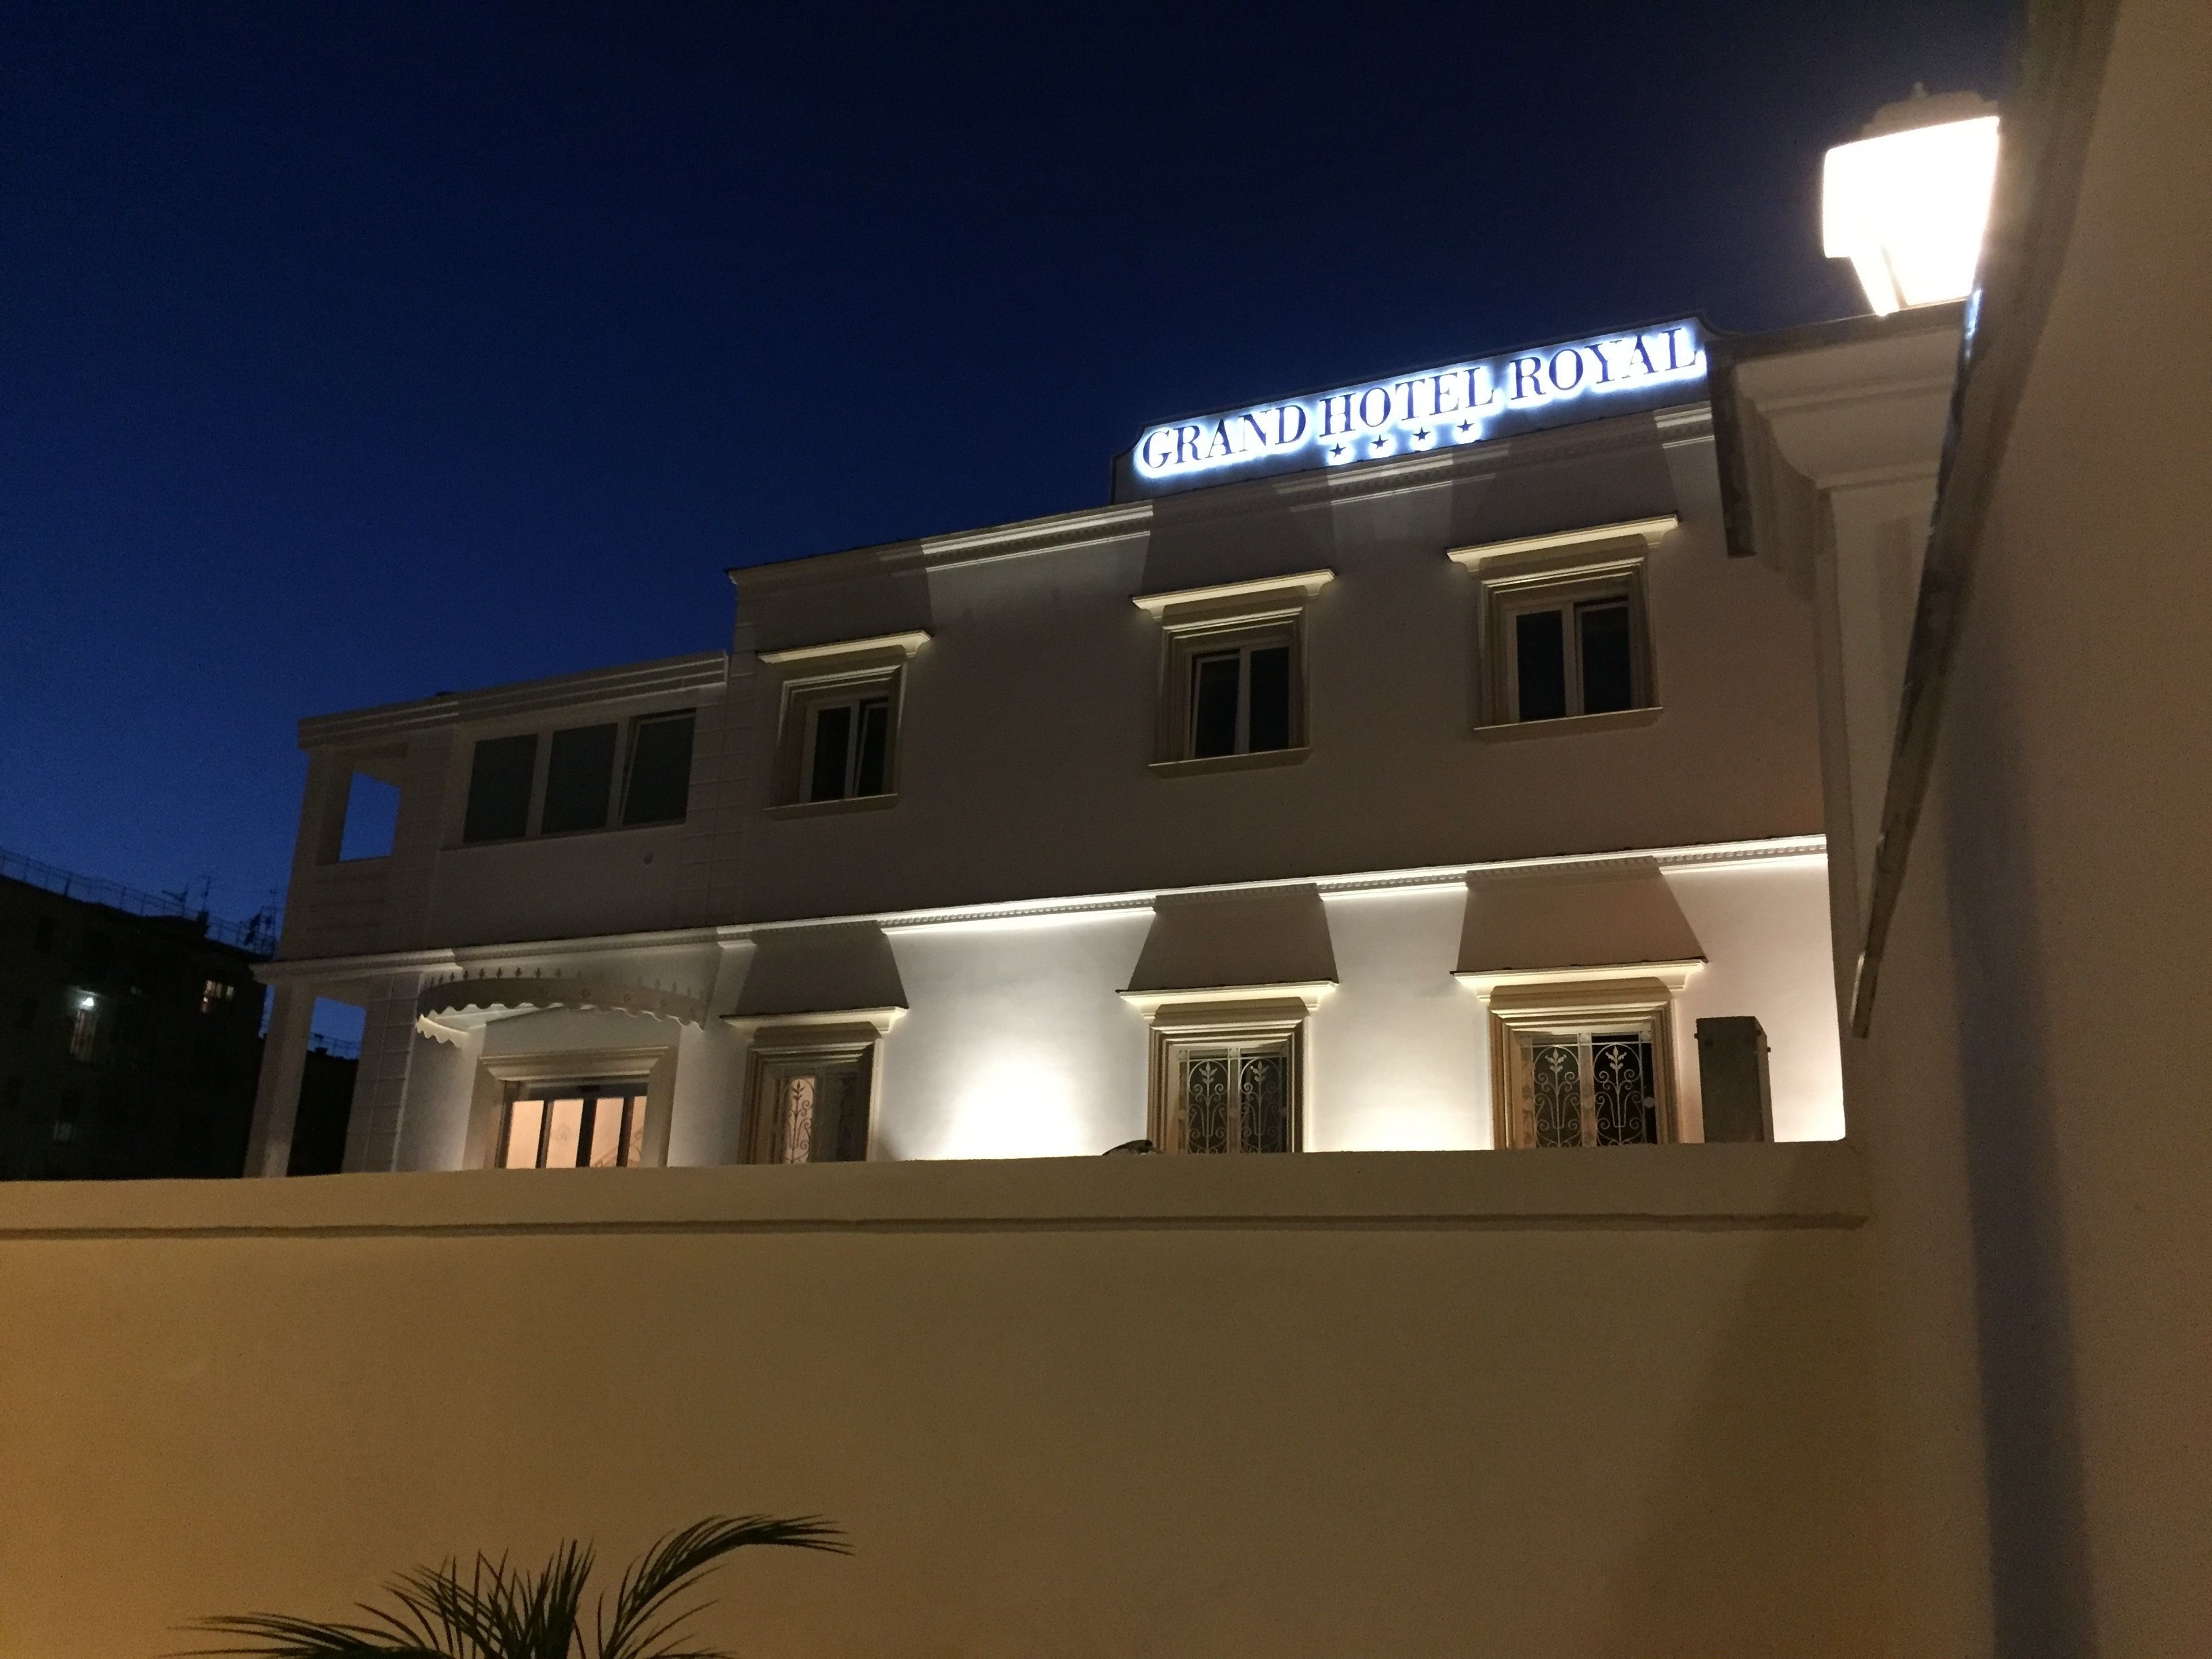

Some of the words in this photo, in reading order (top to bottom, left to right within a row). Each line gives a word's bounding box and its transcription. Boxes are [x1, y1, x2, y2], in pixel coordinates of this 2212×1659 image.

[1142, 405, 1307, 469] GRAND
[1319, 367, 1494, 437] HOTEL
[1511, 328, 1697, 400] ROYAL
